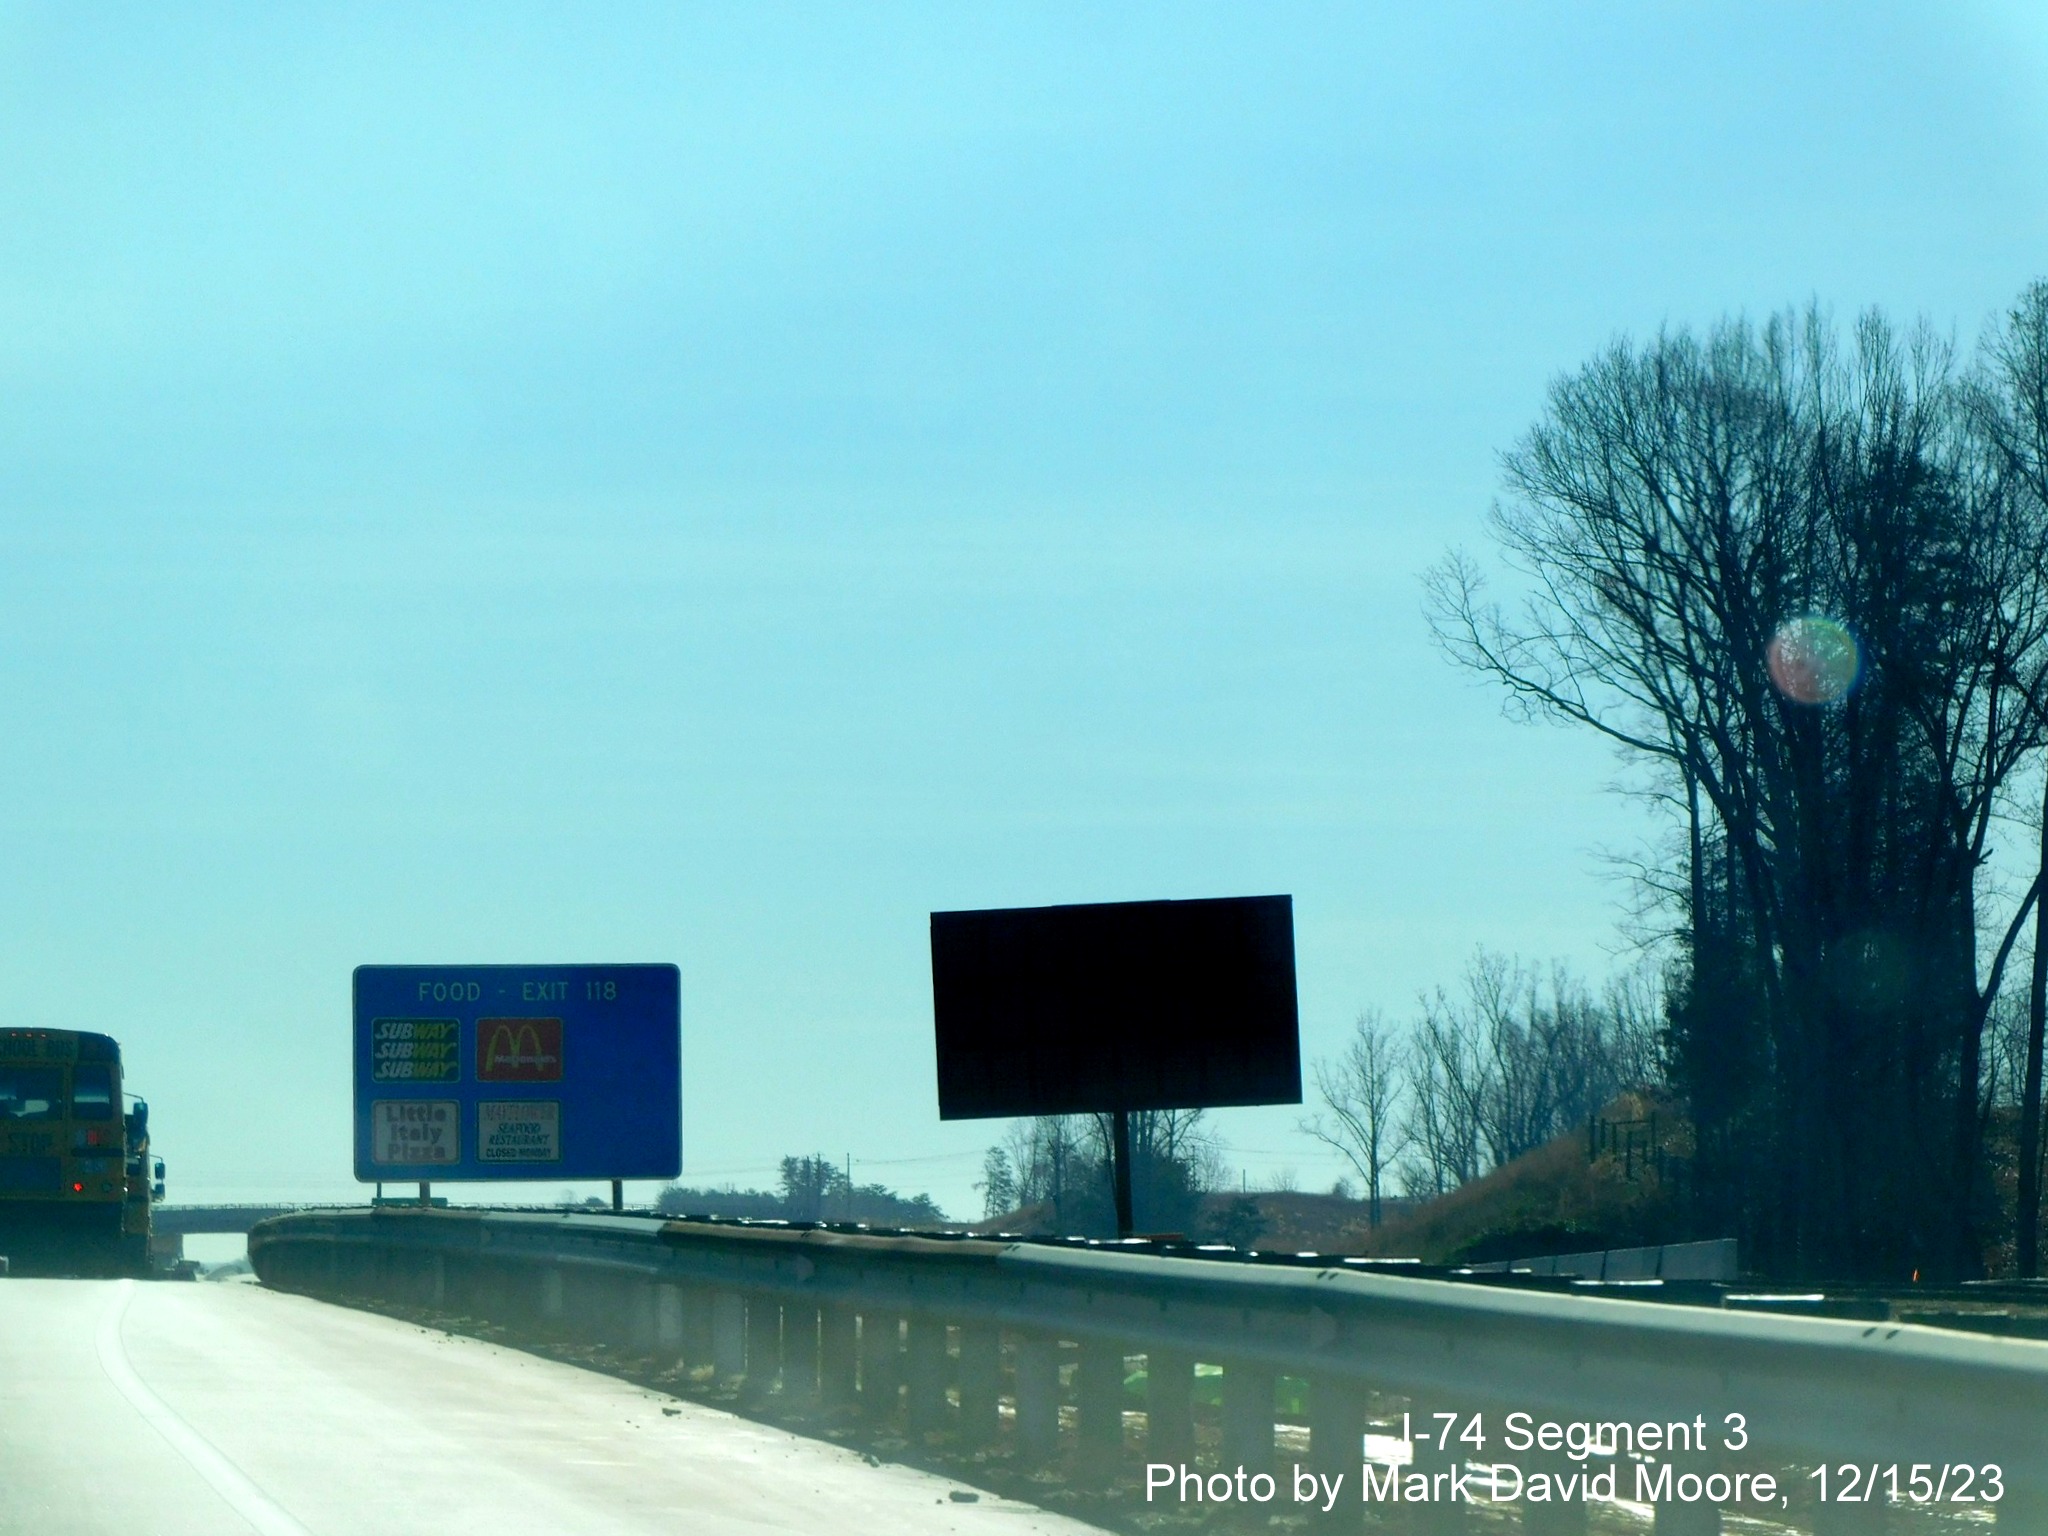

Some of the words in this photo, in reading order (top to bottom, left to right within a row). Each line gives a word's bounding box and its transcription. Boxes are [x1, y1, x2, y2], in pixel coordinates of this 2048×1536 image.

[418, 982, 480, 1001] FOOD
[522, 982, 569, 1000] EXIT
[586, 982, 617, 1000] 118
[375, 1022, 457, 1040] SUBWAY
[375, 1042, 457, 1060] SUBWAY
[375, 1061, 457, 1079] SUBWAY
[386, 1104, 446, 1122] Little
[388, 1144, 445, 1161] Pizza
